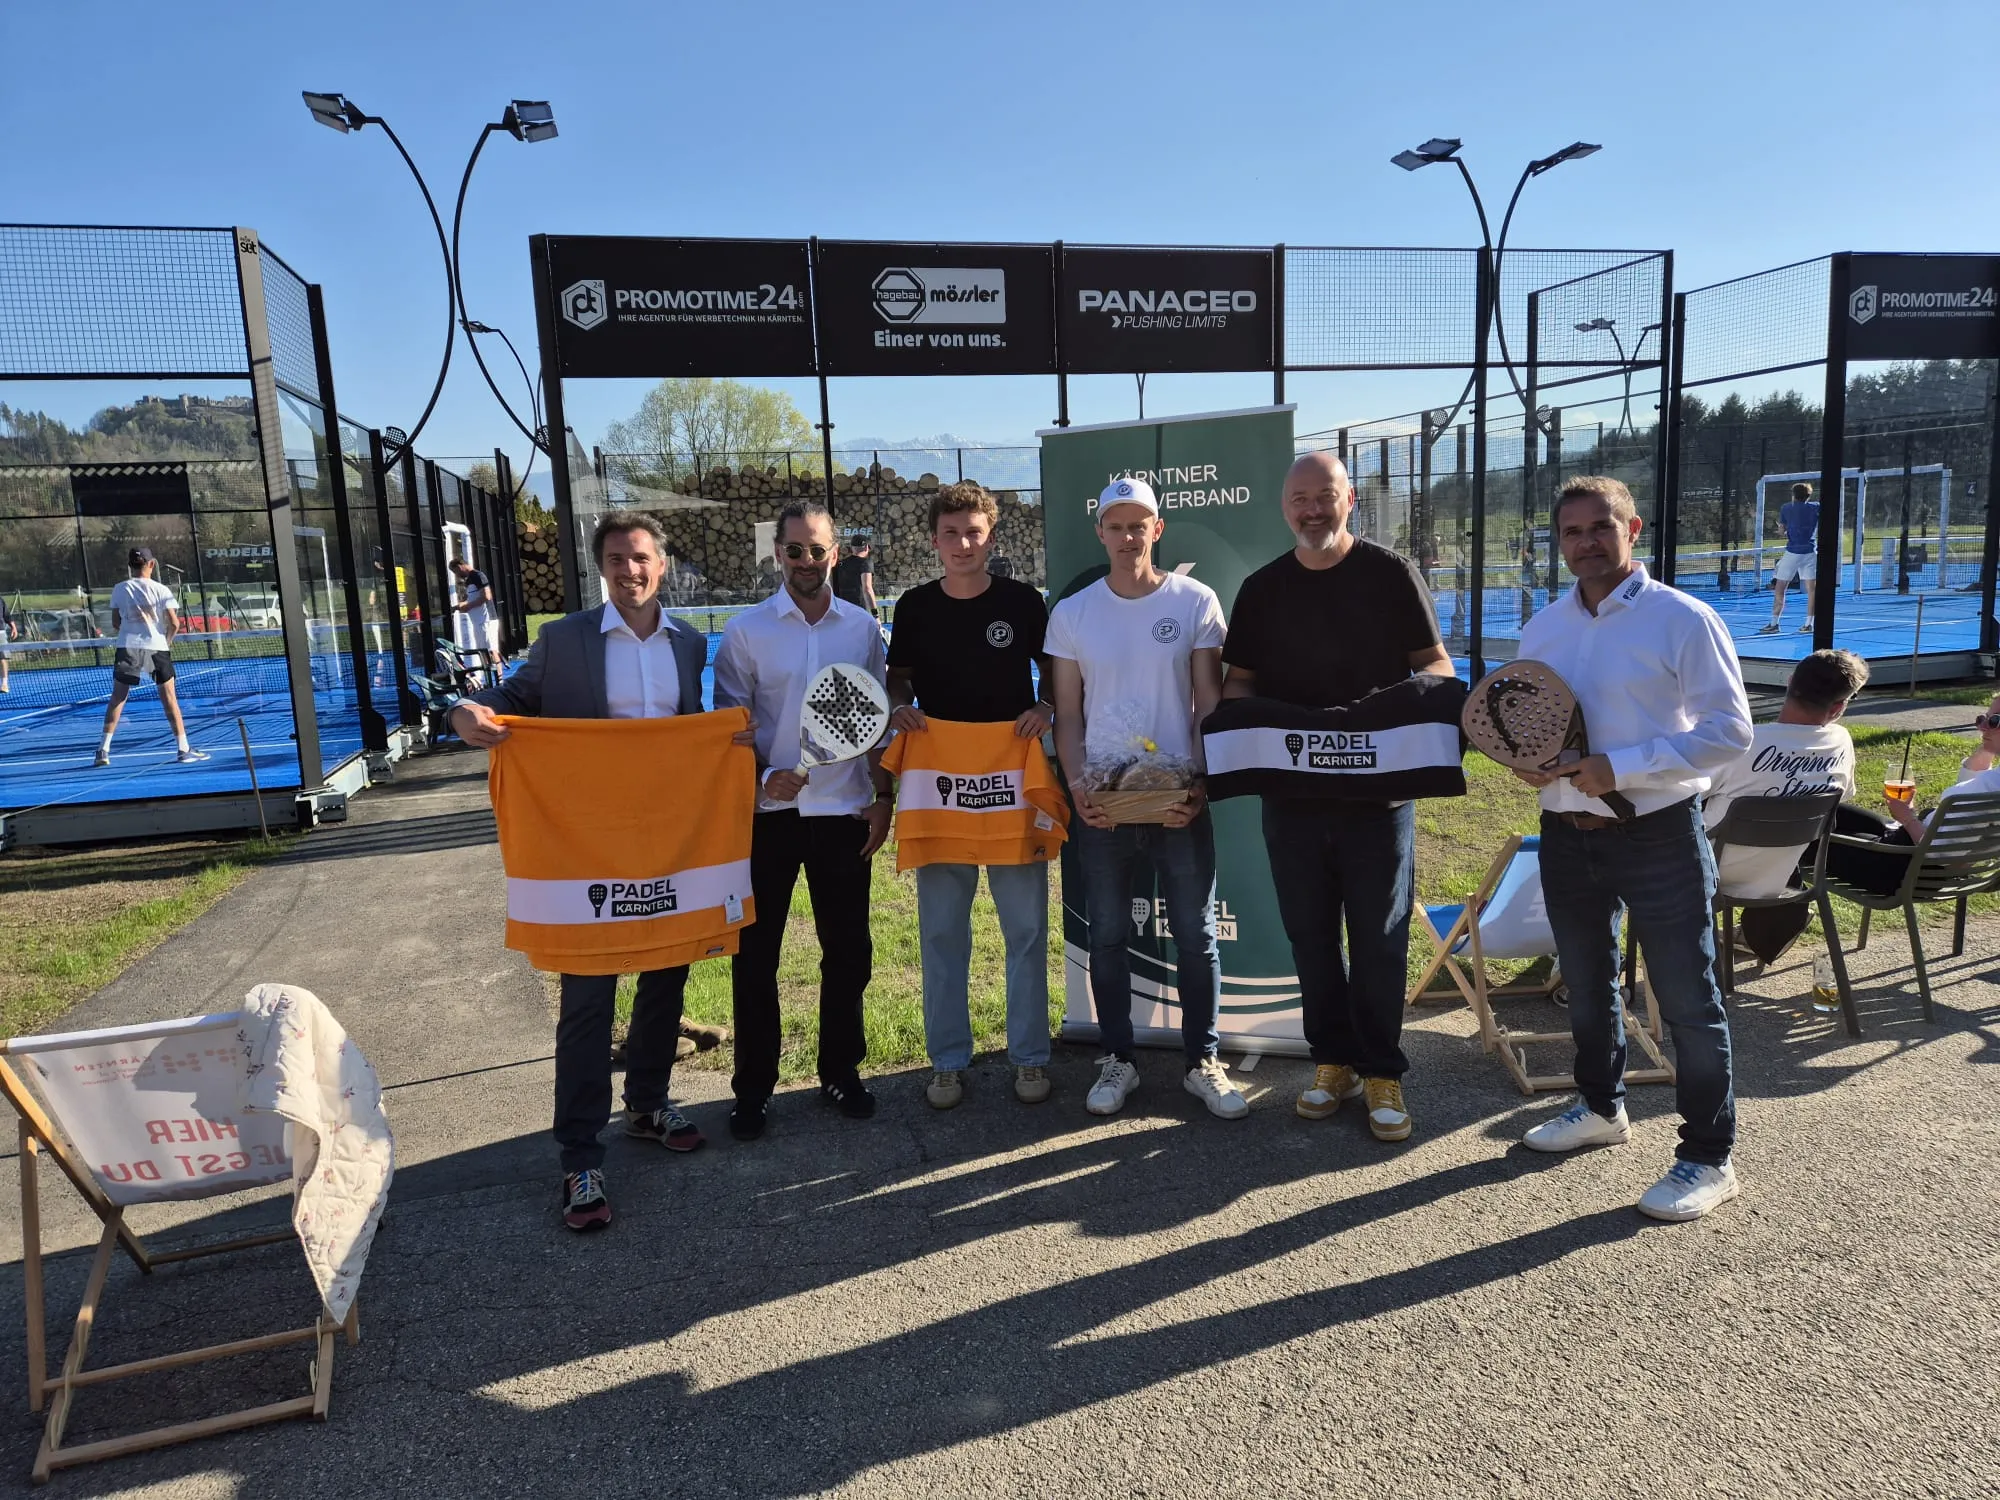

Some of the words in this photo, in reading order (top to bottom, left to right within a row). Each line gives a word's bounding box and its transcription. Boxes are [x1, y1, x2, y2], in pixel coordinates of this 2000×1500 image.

[615, 284, 798, 310] PROMOTIME24
[877, 289, 921, 301] hagebau
[930, 284, 1000, 303] mössler
[1079, 290, 1257, 312] PANACEO
[1881, 286, 1994, 308] PROMOTIME24
[618, 314, 638, 322] IHRE
[638, 314, 677, 323] AGENTUR
[678, 313, 694, 322] FÜR
[695, 314, 756, 323] WERBETECHNIK
[757, 314, 766, 322] IN
[1123, 315, 1182, 328] PUSHING
[1185, 315, 1227, 328] LIMITS
[874, 329, 923, 347] Einer
[929, 333, 964, 347] von
[968, 333, 1007, 347] uns.
[1086, 486, 1250, 516] PVERBAND
[206, 546, 273, 558] PADELB
[1307, 733, 1377, 750] PADEL
[1313, 755, 1372, 766] KÄRNTEN
[955, 774, 1014, 793] PADEL
[960, 793, 1011, 806] KÄRNTEN
[611, 879, 676, 898] PADEL
[615, 898, 673, 914] KÄRNTEN
[1154, 897, 1236, 919] PEL
